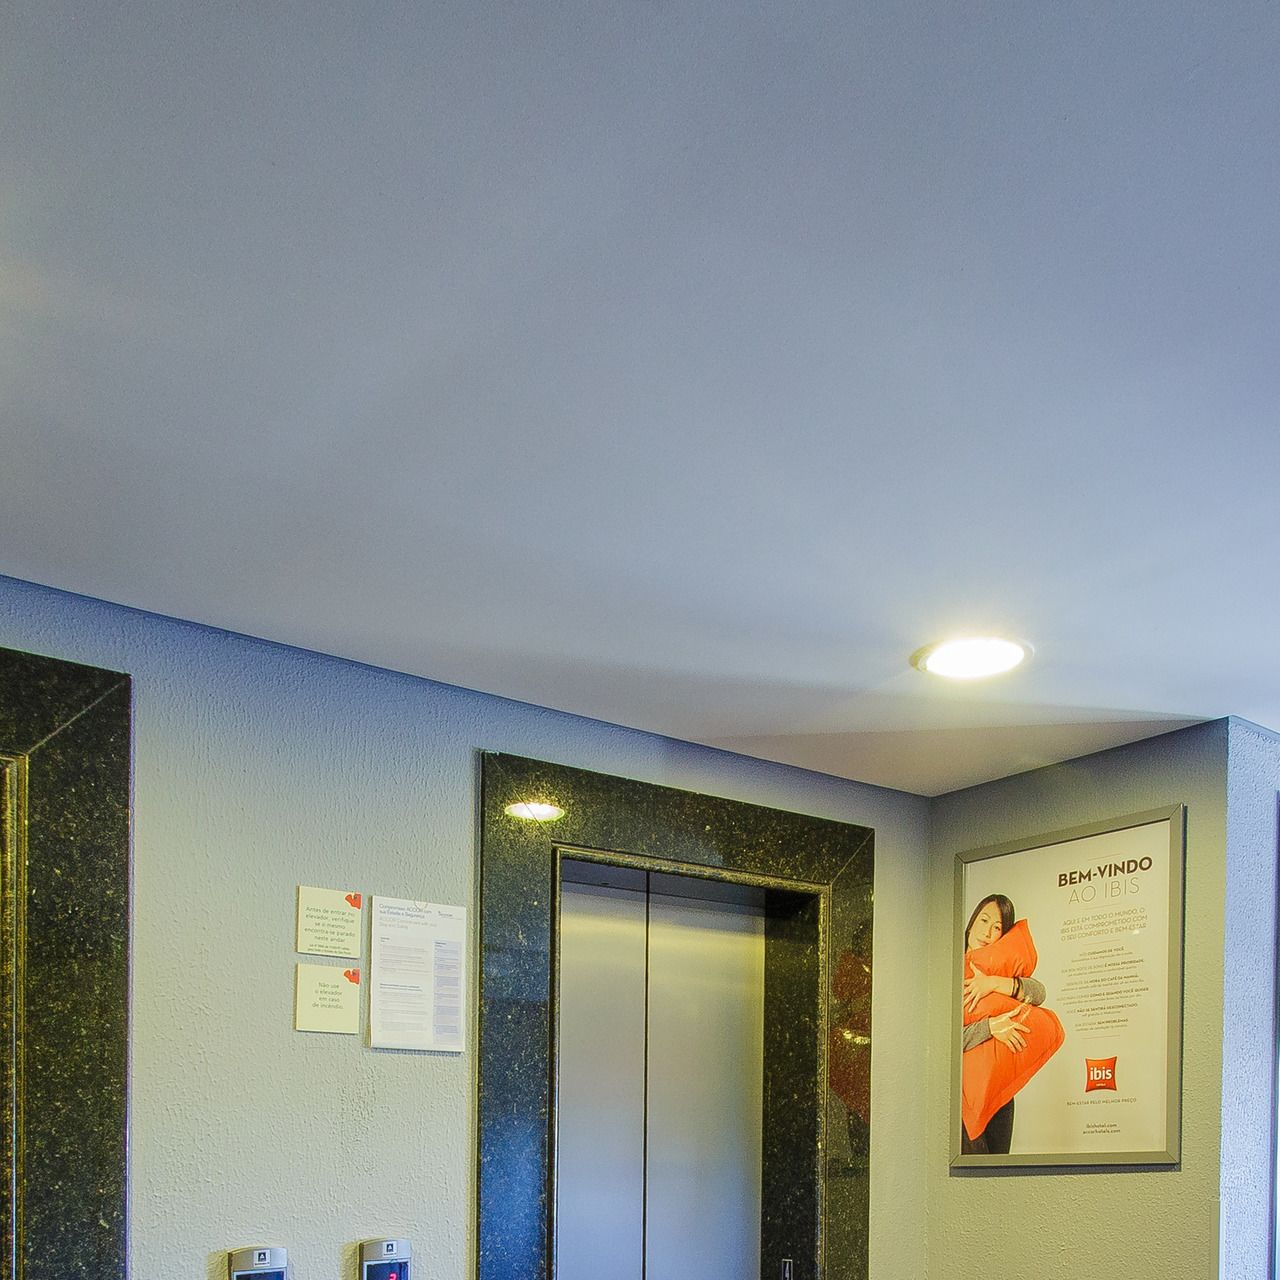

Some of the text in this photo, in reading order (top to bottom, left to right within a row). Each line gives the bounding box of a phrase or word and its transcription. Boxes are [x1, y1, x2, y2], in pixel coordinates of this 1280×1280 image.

[1058, 856, 1152, 887] BEM-VINDO
[1068, 877, 1139, 904] AO IBIS
[1091, 913, 1107, 921] TODO
[1133, 914, 1147, 922] COM
[1078, 928, 1109, 938] CONFORTO
[1090, 1067, 1112, 1080] ibis
